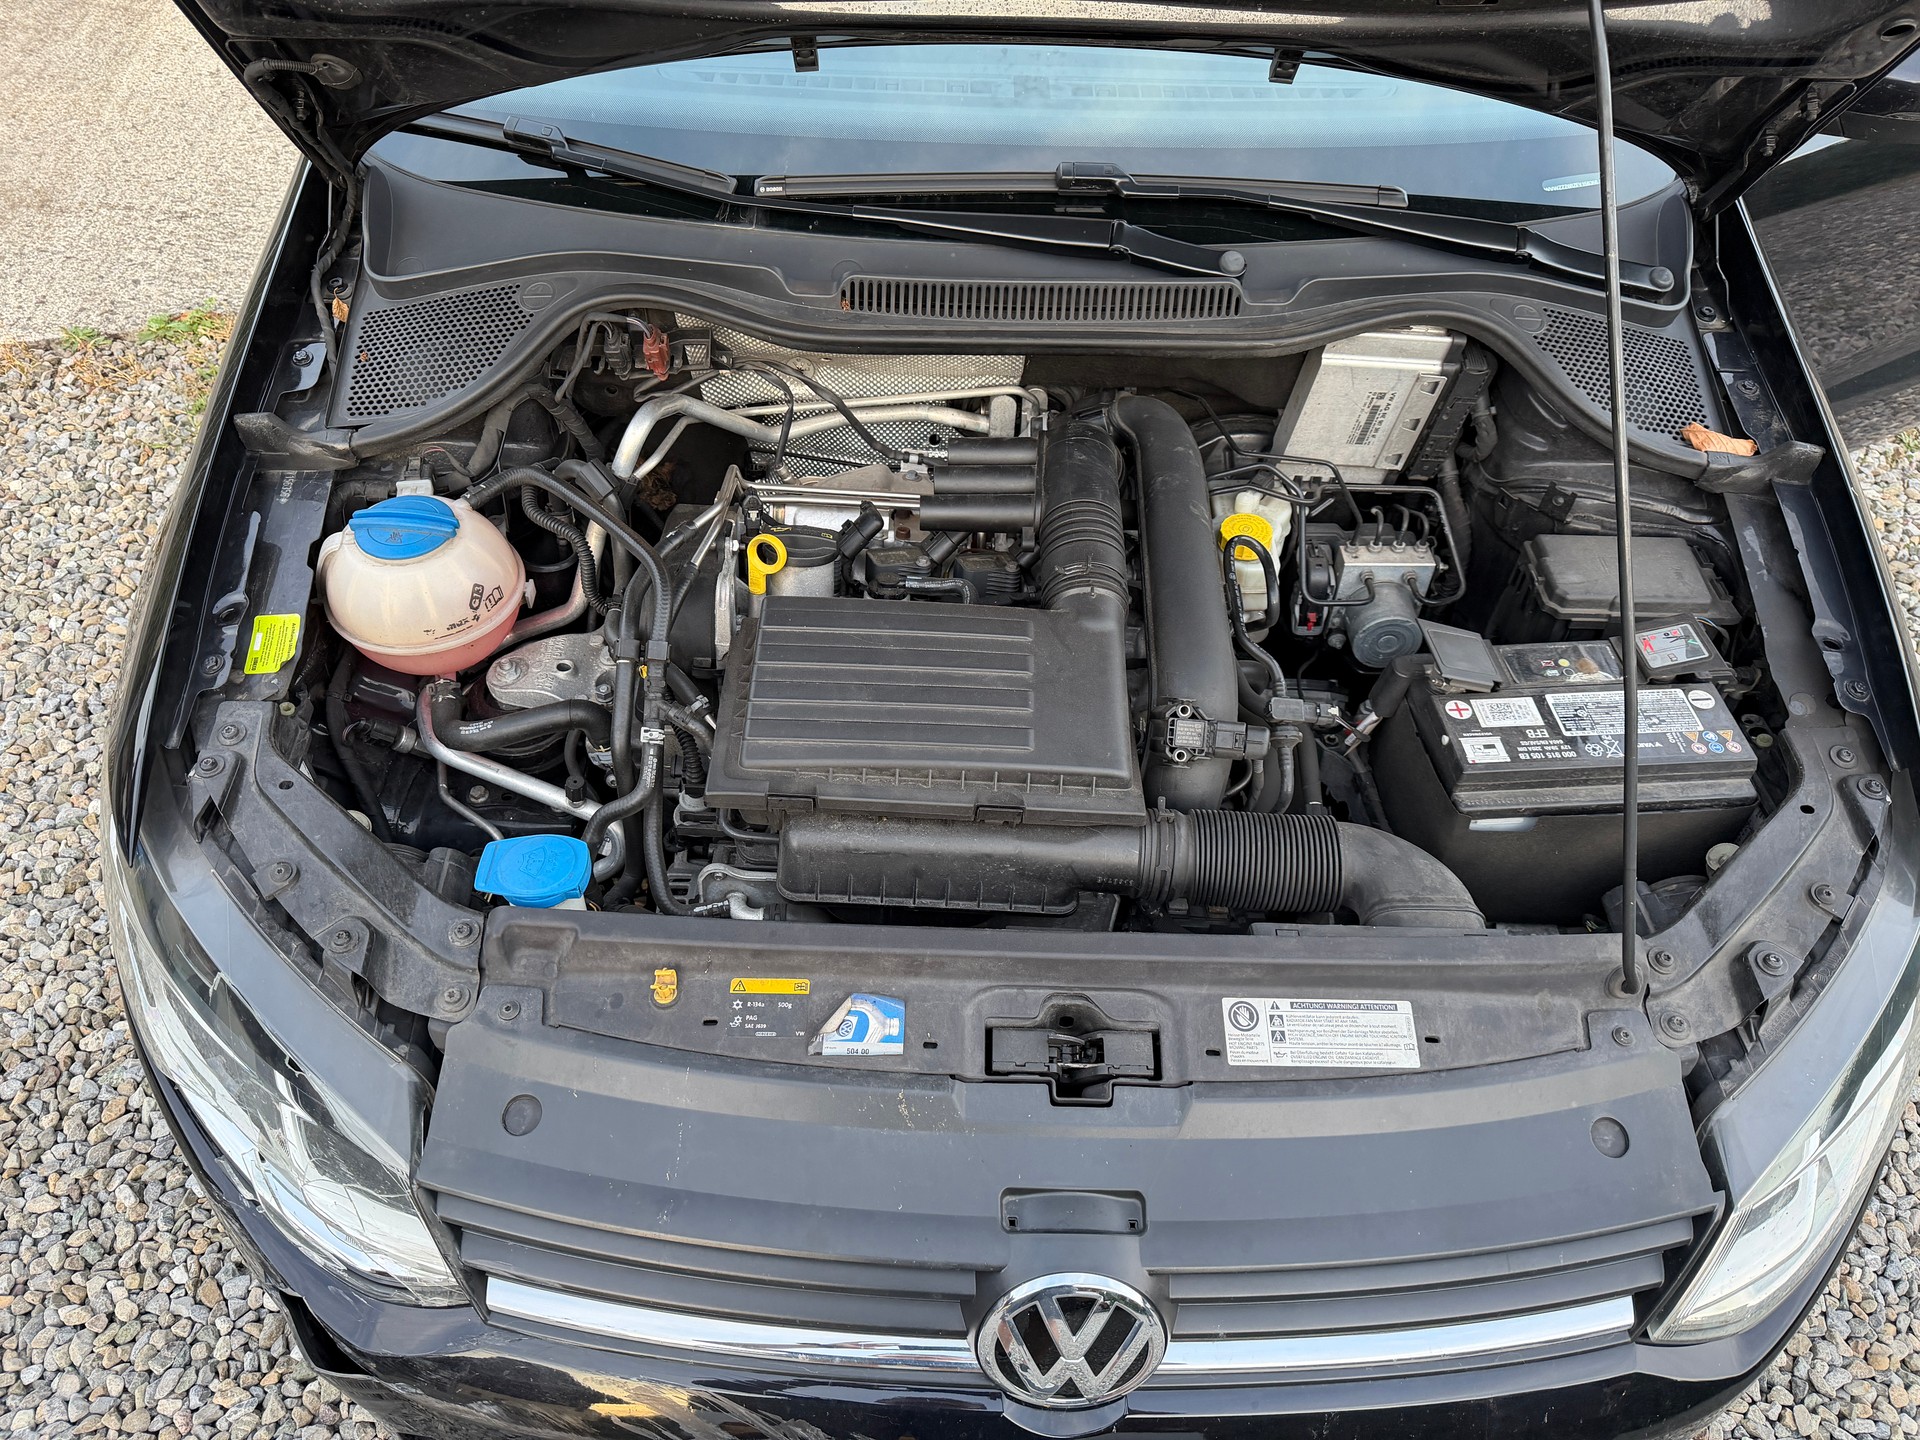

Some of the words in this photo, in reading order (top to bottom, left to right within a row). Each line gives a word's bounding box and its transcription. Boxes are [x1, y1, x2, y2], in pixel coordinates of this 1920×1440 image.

[1525, 728, 1550, 739] EFB
[1530, 752, 1546, 760] 105
[778, 1002, 793, 1010] 500g
[1292, 1002, 1326, 1010] ACHTUNG!
[1326, 1003, 1360, 1011] WARNING!
[846, 1047, 859, 1055] 504
[990, 1285, 1158, 1405] VW
